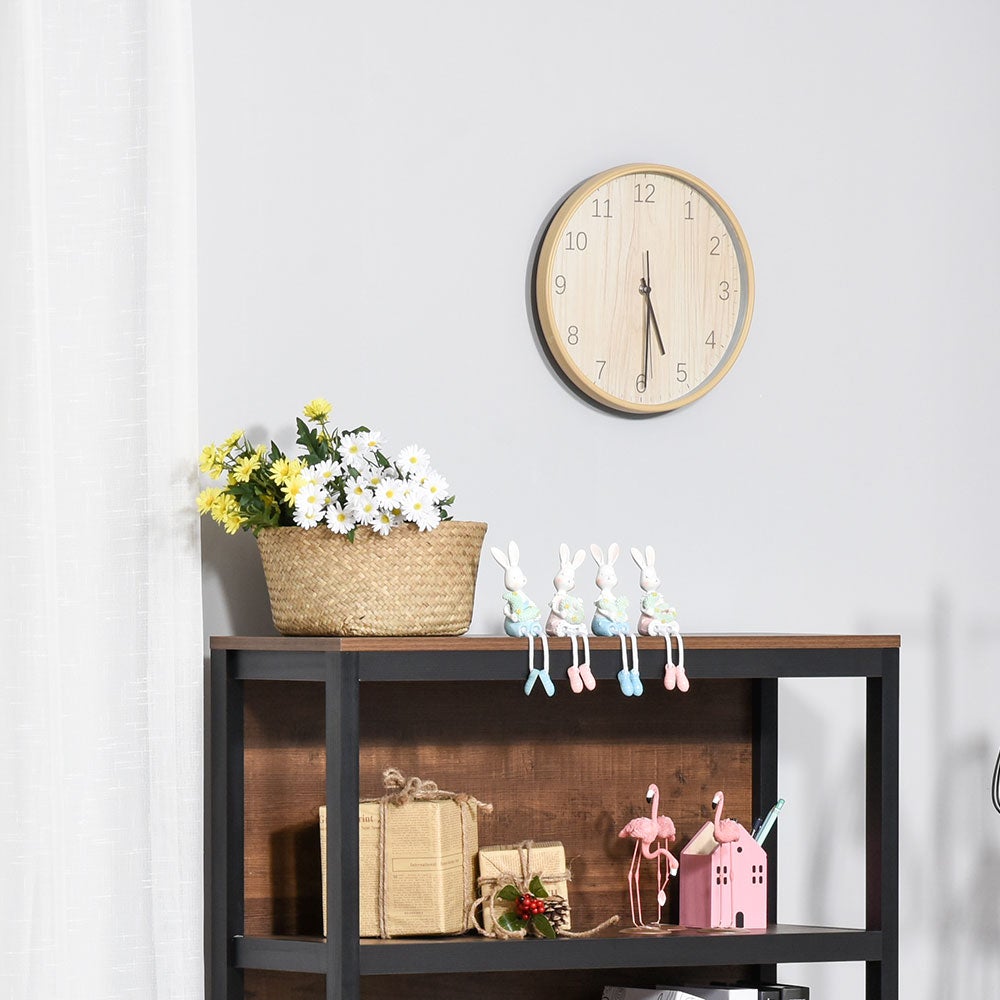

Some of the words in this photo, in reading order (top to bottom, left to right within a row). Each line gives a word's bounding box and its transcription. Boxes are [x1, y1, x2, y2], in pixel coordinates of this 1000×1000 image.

[634, 183, 656, 204] 12
[591, 198, 613, 218] 11
[684, 200, 694, 220] 1
[565, 231, 588, 251] 10
[709, 235, 721, 256] 2
[554, 275, 567, 295] 9
[718, 280, 730, 301] 3
[567, 325, 579, 346] 8
[704, 330, 716, 350] 4
[595, 360, 607, 380] 7
[676, 362, 688, 383] 5
[635, 373, 646, 394] 6
